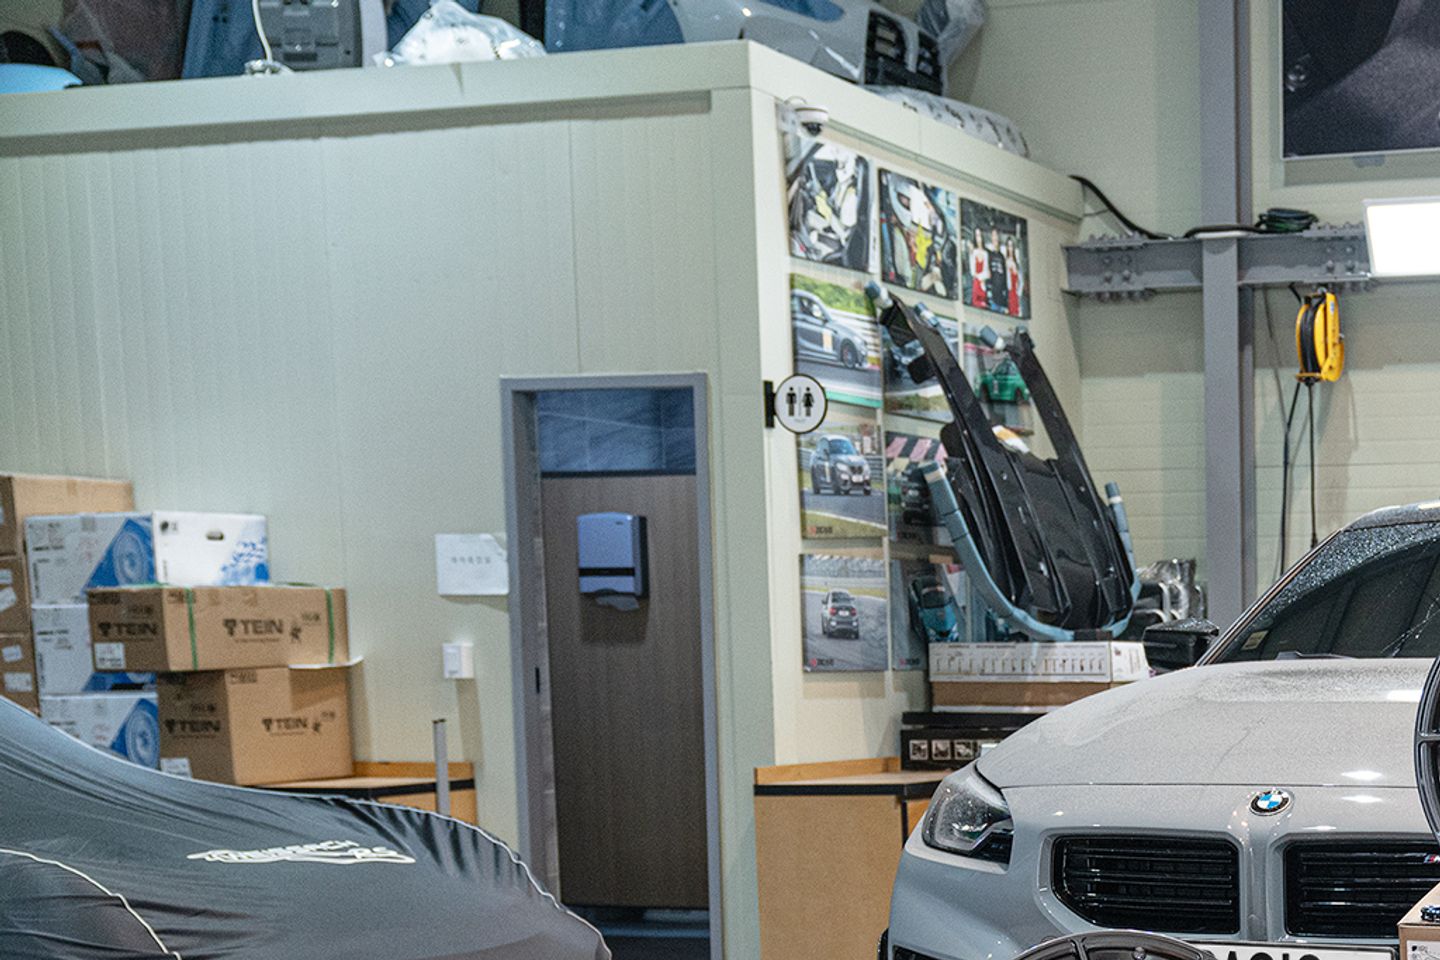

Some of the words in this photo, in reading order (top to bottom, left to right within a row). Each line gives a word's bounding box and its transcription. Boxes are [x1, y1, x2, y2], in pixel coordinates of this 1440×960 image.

[116, 623, 157, 635] TEIN
[241, 619, 283, 634] TEIN
[179, 720, 220, 732] TEIN
[276, 718, 308, 730] TEIN
